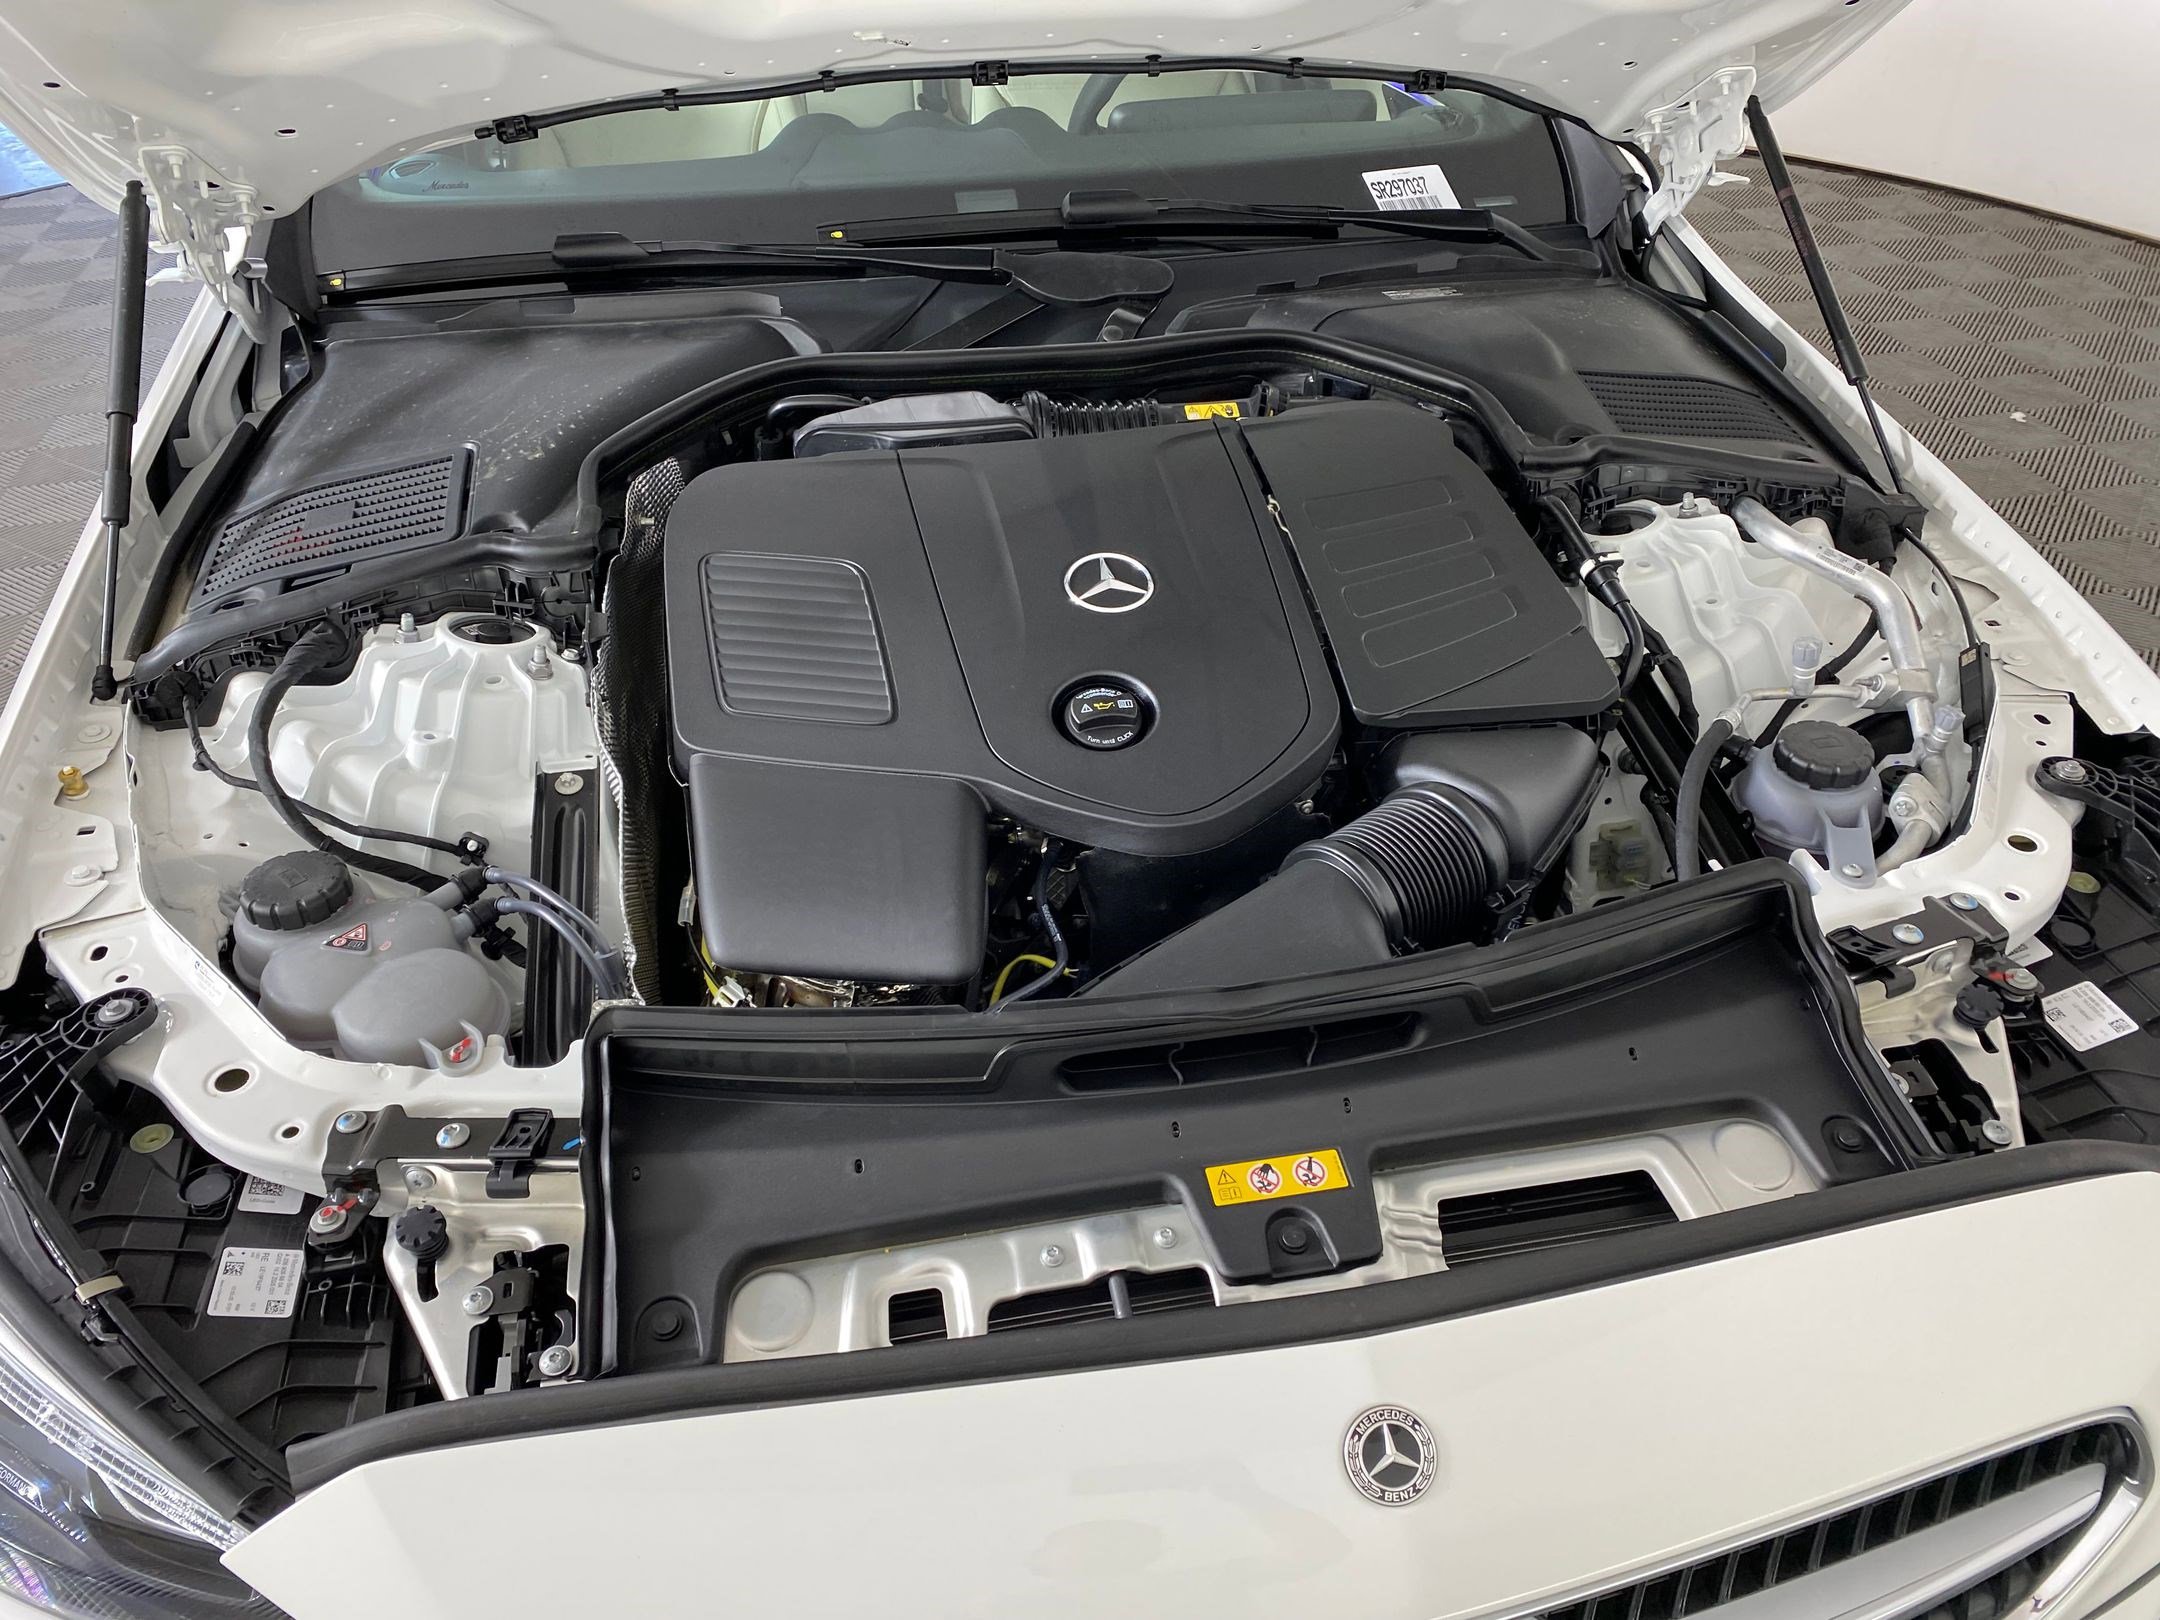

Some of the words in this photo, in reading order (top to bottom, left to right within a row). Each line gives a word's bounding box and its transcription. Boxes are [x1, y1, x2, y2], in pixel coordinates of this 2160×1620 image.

[1371, 176, 1429, 199] SR297037
[1087, 735, 1101, 744] Turn
[1117, 731, 1134, 742] CLICK
[1355, 1409, 1414, 1435] MERCEDES
[1384, 1487, 1416, 1502] BENZ
